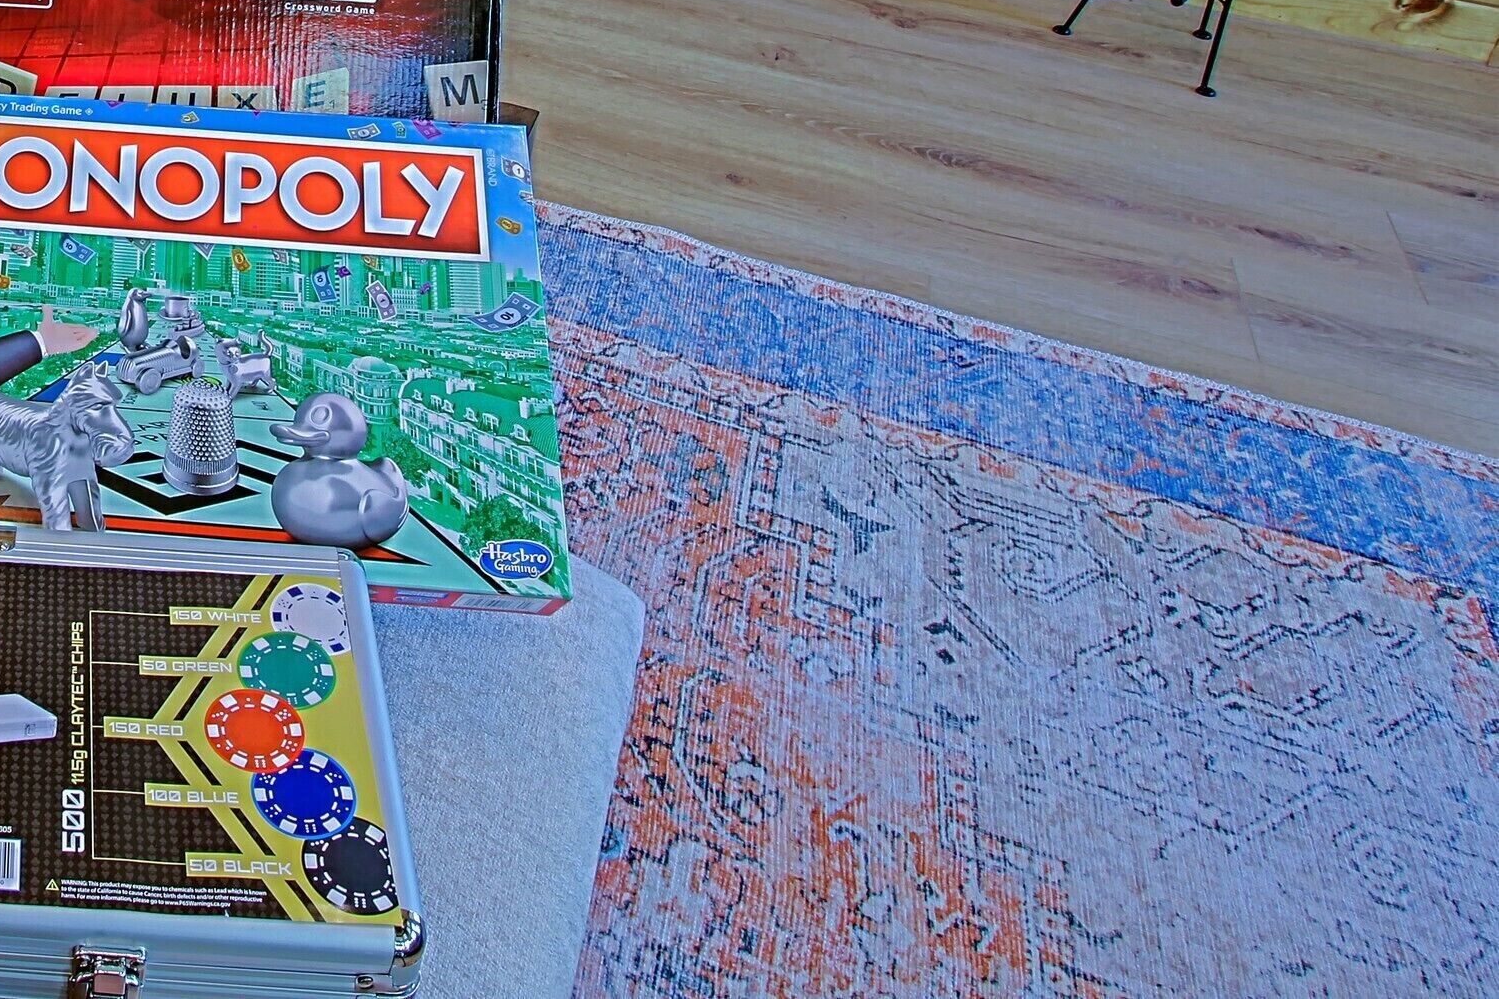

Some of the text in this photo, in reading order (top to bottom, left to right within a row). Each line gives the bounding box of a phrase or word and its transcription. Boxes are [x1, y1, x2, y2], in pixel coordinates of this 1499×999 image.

[284, 2, 375, 15] Crossword Game
[440, 74, 480, 107] M
[9, 102, 49, 116] Trading
[51, 104, 83, 116] Game
[482, 543, 547, 565] Hasbro
[494, 559, 540, 577] Gaming
[173, 610, 262, 624] 150 WHITE
[71, 621, 84, 665] CHIPS
[142, 661, 234, 674] 50 GREEN
[109, 722, 184, 736] 150 RED
[71, 750, 88, 785] 11.5g
[147, 790, 239, 803] 100 BLUE
[62, 789, 85, 853] 500
[189, 860, 293, 876] 50 BLACK
[229, 895, 263, 903] reproductive
